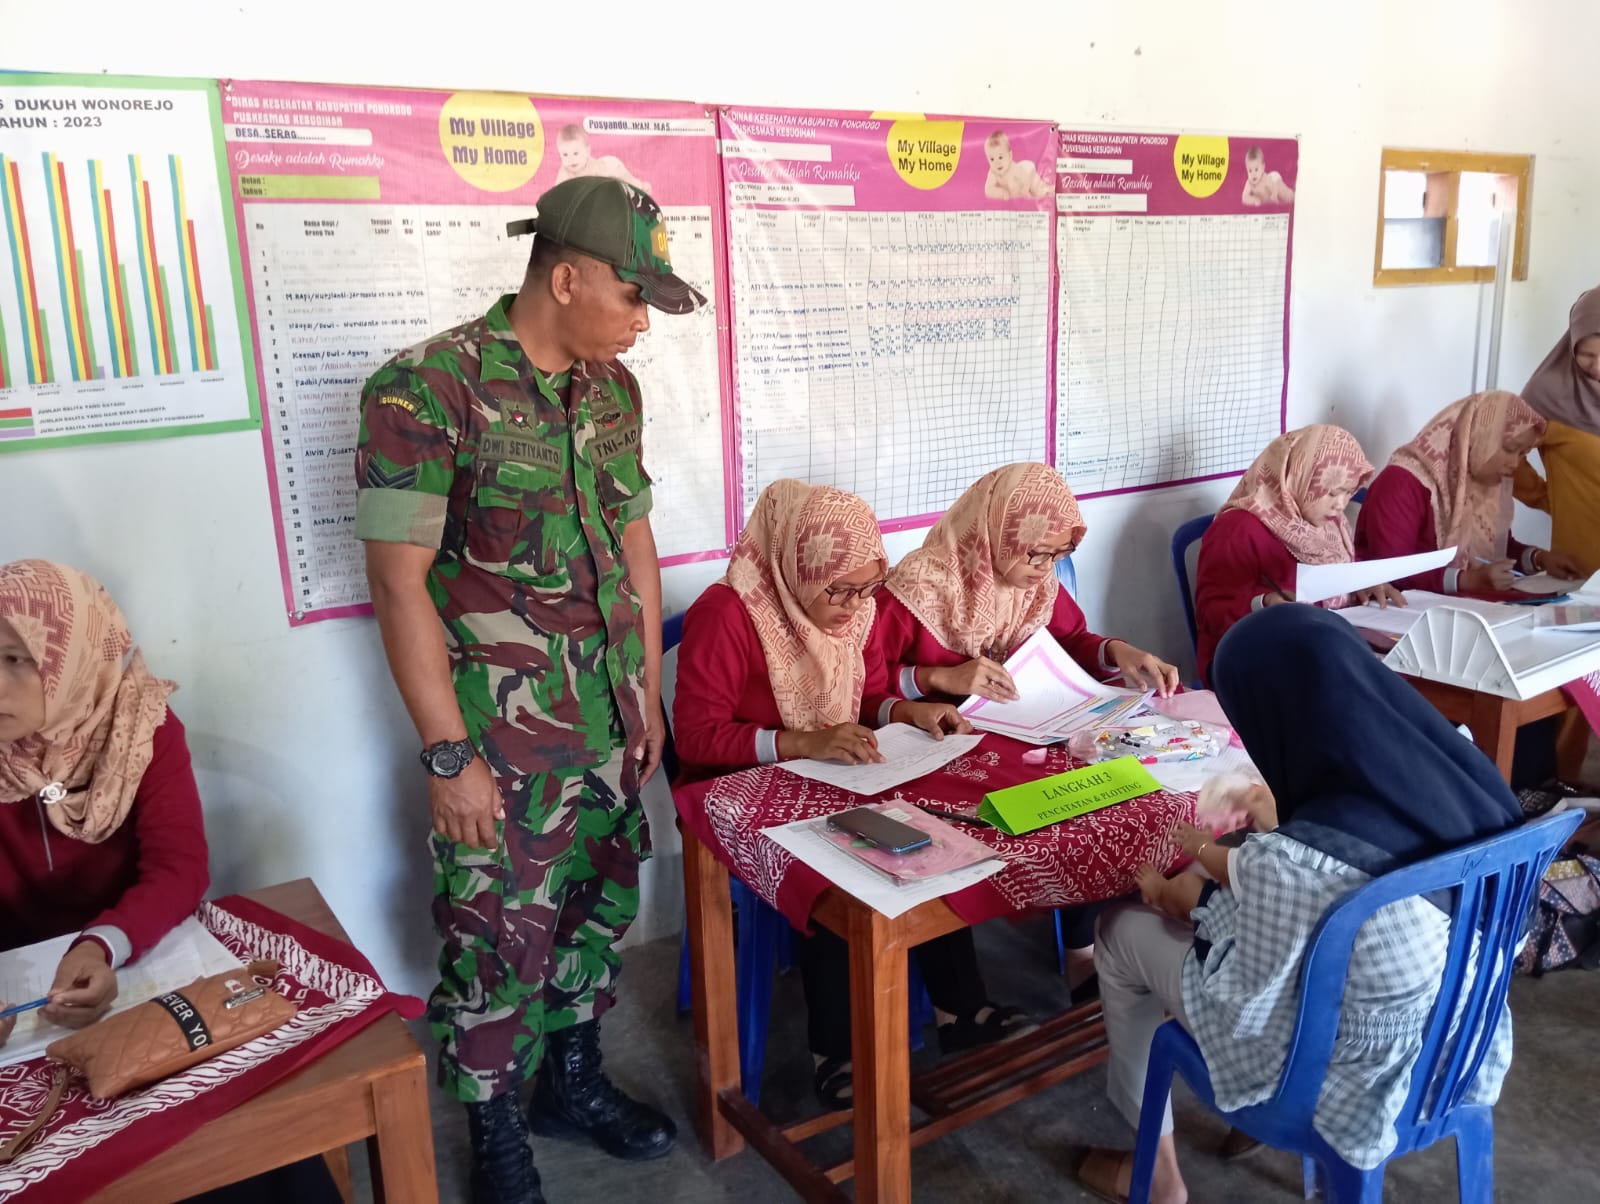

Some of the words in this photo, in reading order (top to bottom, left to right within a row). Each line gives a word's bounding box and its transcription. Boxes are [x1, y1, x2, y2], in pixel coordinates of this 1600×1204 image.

[15, 99, 77, 111] DUKUH
[82, 100, 174, 111] WONOREJO
[232, 96, 260, 108] DINAS
[367, 103, 412, 116] PONOROGO
[0, 117, 48, 128] AHUN
[64, 117, 102, 128] 2023
[233, 112, 290, 124] PUSKESMAS
[754, 113, 797, 126] KESEHATAN
[799, 116, 839, 128] KABUPATEN
[841, 121, 881, 130] PONOROGO
[450, 117, 475, 137] My
[481, 118, 535, 138] Village
[453, 146, 478, 165] My
[484, 147, 527, 165] Home
[898, 140, 915, 155] My
[918, 141, 957, 156] Village
[285, 152, 325, 165] adalah
[899, 158, 916, 173] My
[919, 159, 952, 171] Home
[1182, 153, 1195, 168] My
[1197, 154, 1226, 168] Village
[813, 163, 860, 181] Rumahku
[1182, 169, 1195, 183] My
[1197, 169, 1222, 180] Home
[382, 396, 414, 412] GUNNER
[509, 440, 559, 464] SETIYANTO
[595, 430, 637, 458] TNI-AD
[1042, 774, 1104, 800] LANGKAH
[1103, 771, 1113, 783] 3
[1037, 796, 1093, 820] PENCATATAN
[1100, 781, 1142, 800] PLOTTING
[160, 993, 194, 1022] EVER
